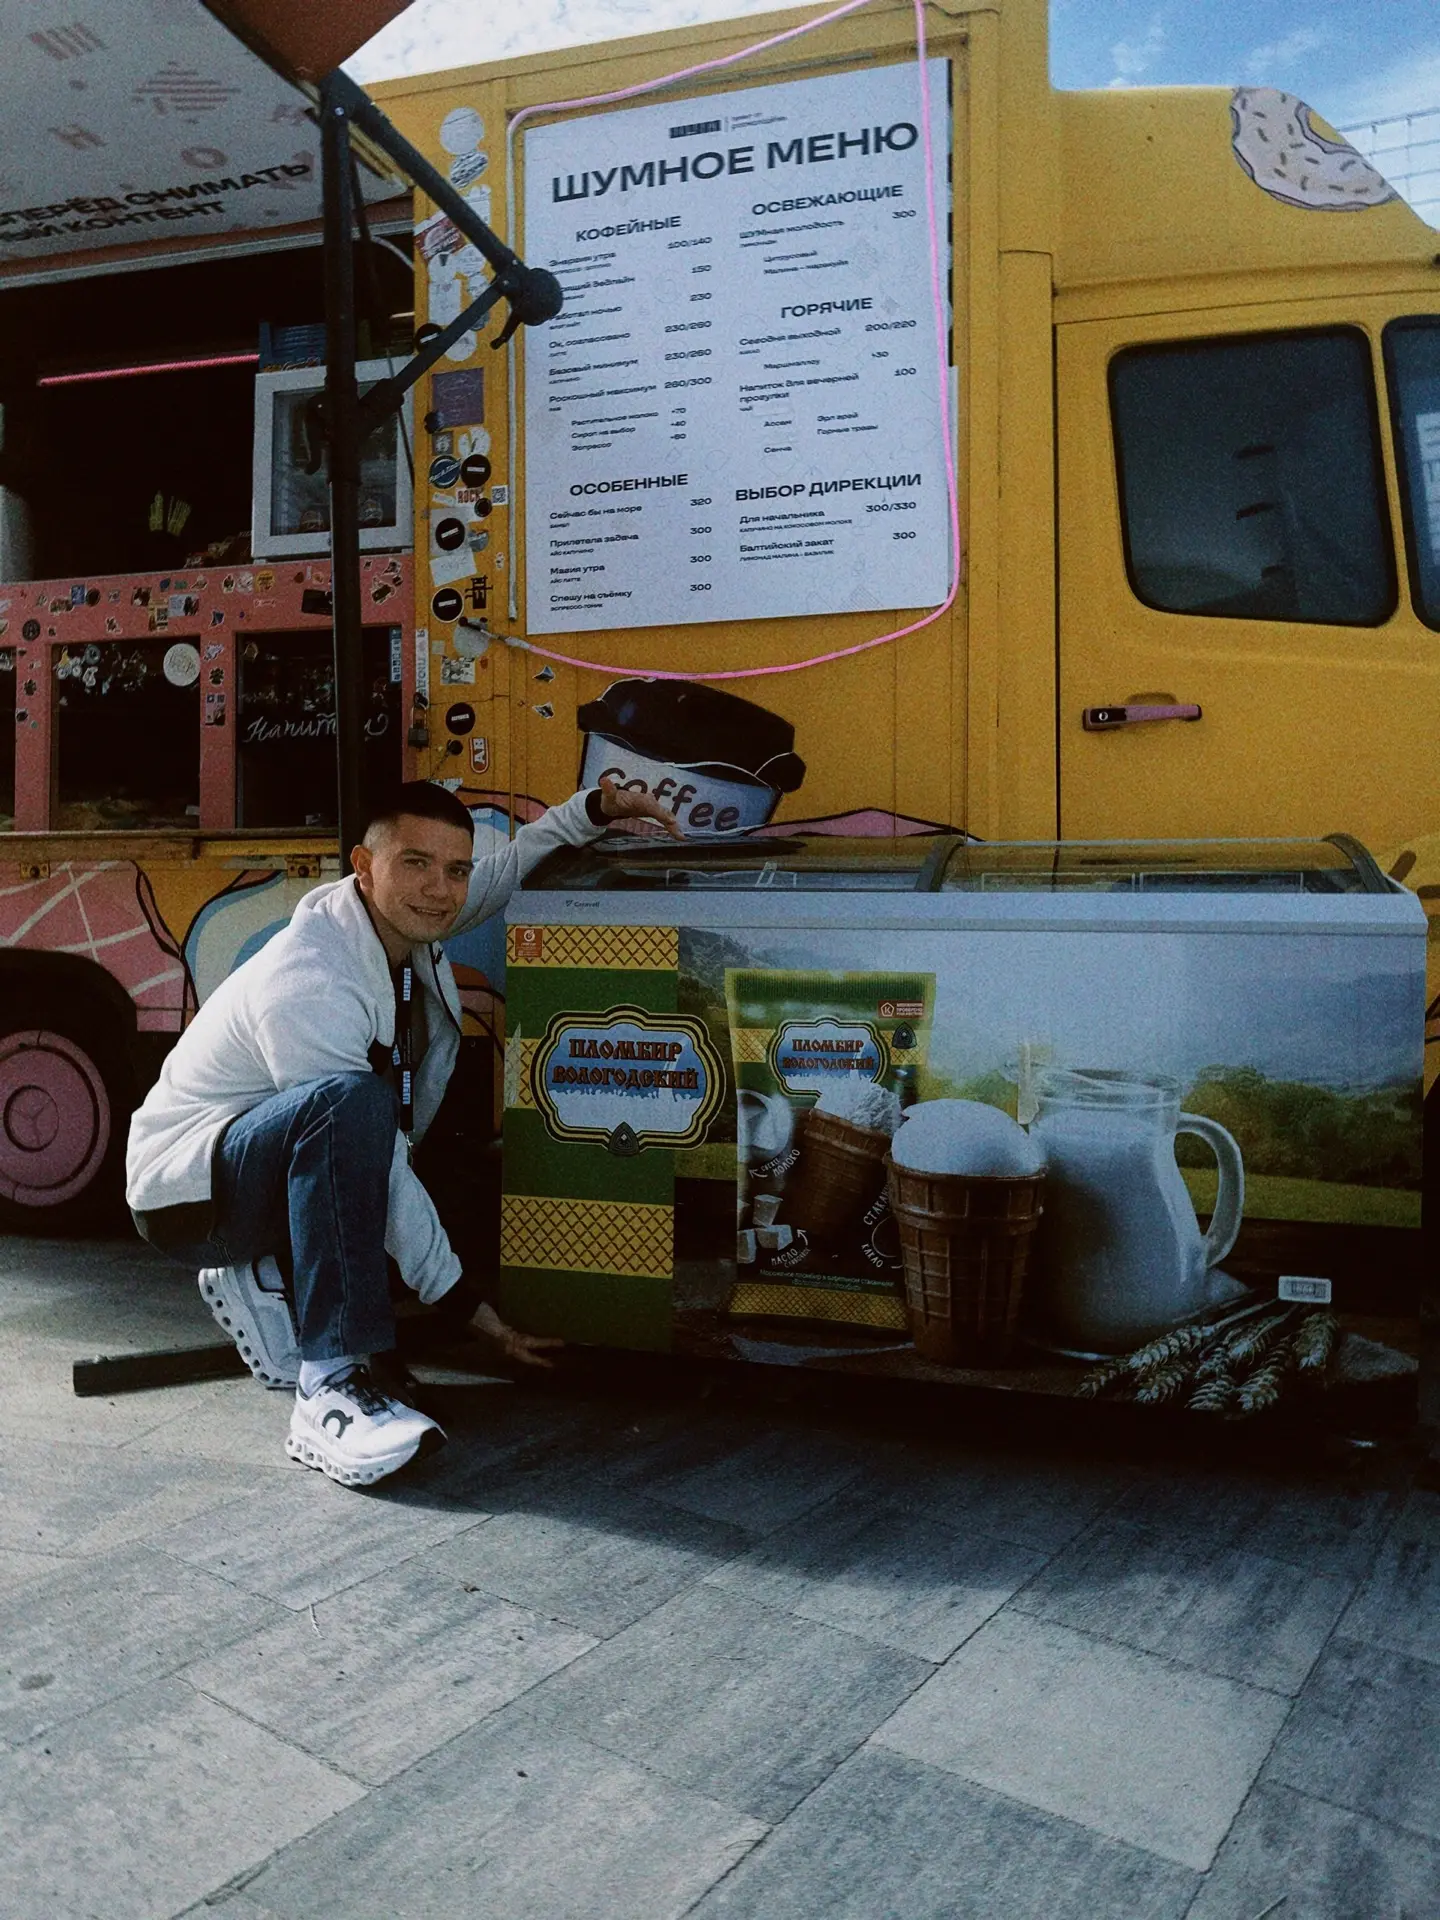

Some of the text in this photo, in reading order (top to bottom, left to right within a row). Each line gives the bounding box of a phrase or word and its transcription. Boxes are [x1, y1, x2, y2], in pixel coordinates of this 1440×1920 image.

[552, 122, 919, 203] ШУМНОЕ МЕНЮ
[124, 163, 311, 206] СНИМАТЬ
[752, 185, 904, 215] ОСВЕЖАЮЩИЕ
[892, 210, 917, 219] 300
[576, 215, 681, 242] КОФЕЙНЫЕ
[691, 265, 712, 273] 150
[689, 292, 712, 301] 230
[781, 297, 873, 318] ГОРЯЧИЕ
[865, 320, 917, 332] 200/220
[739, 335, 786, 346] Сегодня
[549, 364, 592, 376] Базовый
[894, 367, 917, 376] 100
[739, 382, 785, 393] Напиток
[786, 379, 805, 388] для
[549, 390, 605, 403] Роскошный
[739, 392, 790, 404] прогулки
[570, 474, 688, 496] ОСОБЕННЫЕ
[735, 473, 922, 501] ВЫБОР ДИРЕКЦИИ
[690, 498, 712, 506] 320
[866, 502, 917, 513] 300/330
[550, 505, 642, 520] Сейчас бы на море
[739, 510, 825, 525] Для начальника
[690, 526, 712, 535] 300
[892, 531, 917, 540] 300
[550, 533, 639, 549] Прилетела задача
[739, 538, 835, 552] Балтийский закат
[690, 555, 712, 563] 300
[550, 564, 606, 576] Магия утра
[690, 583, 712, 592] 300
[550, 590, 632, 604] Спешу на съёмку
[568, 1038, 683, 1062] ПЛОМБИР
[792, 1038, 865, 1053] ПЛОМБИР
[783, 1056, 875, 1071] ВОЛОГОДСКИЙ
[552, 1066, 699, 1090] ВОЛОГОДСКИЙ
[773, 1149, 800, 1177] МОЛОКО
